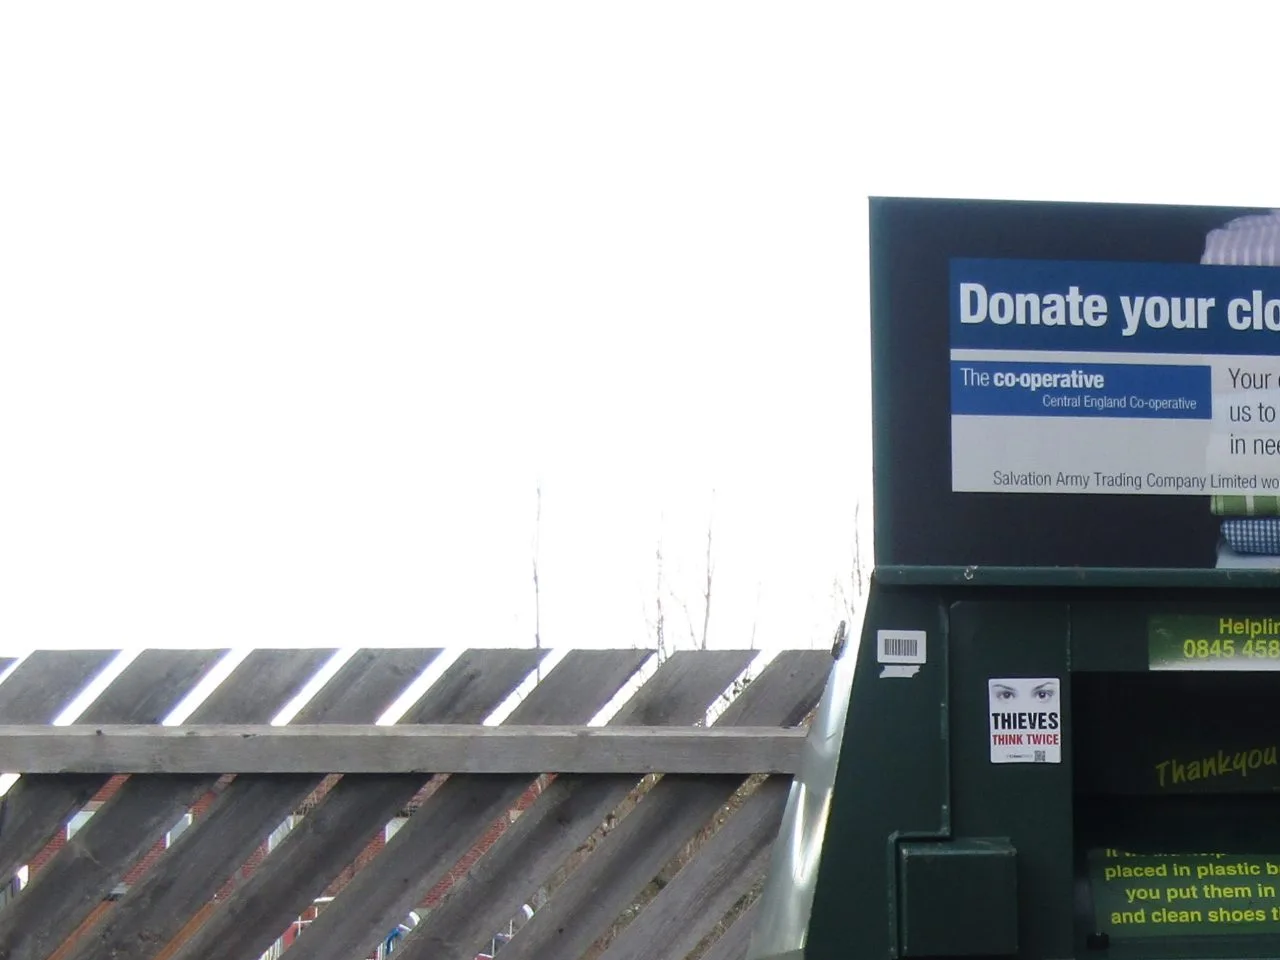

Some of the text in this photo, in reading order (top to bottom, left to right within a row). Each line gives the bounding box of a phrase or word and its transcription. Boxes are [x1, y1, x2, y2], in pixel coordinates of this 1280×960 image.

[960, 283, 1107, 327] Donate
[1120, 295, 1215, 336] your
[960, 368, 1104, 391] The co-operative
[1228, 368, 1272, 390] Your
[1042, 394, 1197, 411] Central England Co-operative
[1230, 406, 1251, 422] us
[1258, 401, 1276, 422] to
[1230, 433, 1247, 454] in
[993, 470, 1051, 487] Salvation
[1056, 472, 1090, 488] Army
[1093, 472, 1142, 490] Trading
[1147, 473, 1207, 491] Company
[1211, 474, 1257, 489] Limited
[1183, 639, 1235, 659] 0845
[991, 712, 1059, 730] THIEVES
[992, 733, 1059, 745] THINK TWICE
[1155, 746, 1278, 788] Thankyou
[1104, 864, 1168, 881] placed
[1173, 863, 1191, 877] in
[1197, 862, 1261, 879] plastic
[1125, 888, 1160, 903] you
[1166, 884, 1199, 903] put
[1203, 884, 1252, 899] them
[1258, 883, 1276, 898] in
[1111, 908, 1145, 924] and
[1151, 908, 1202, 923] clean
[1208, 907, 1266, 922] shoes
